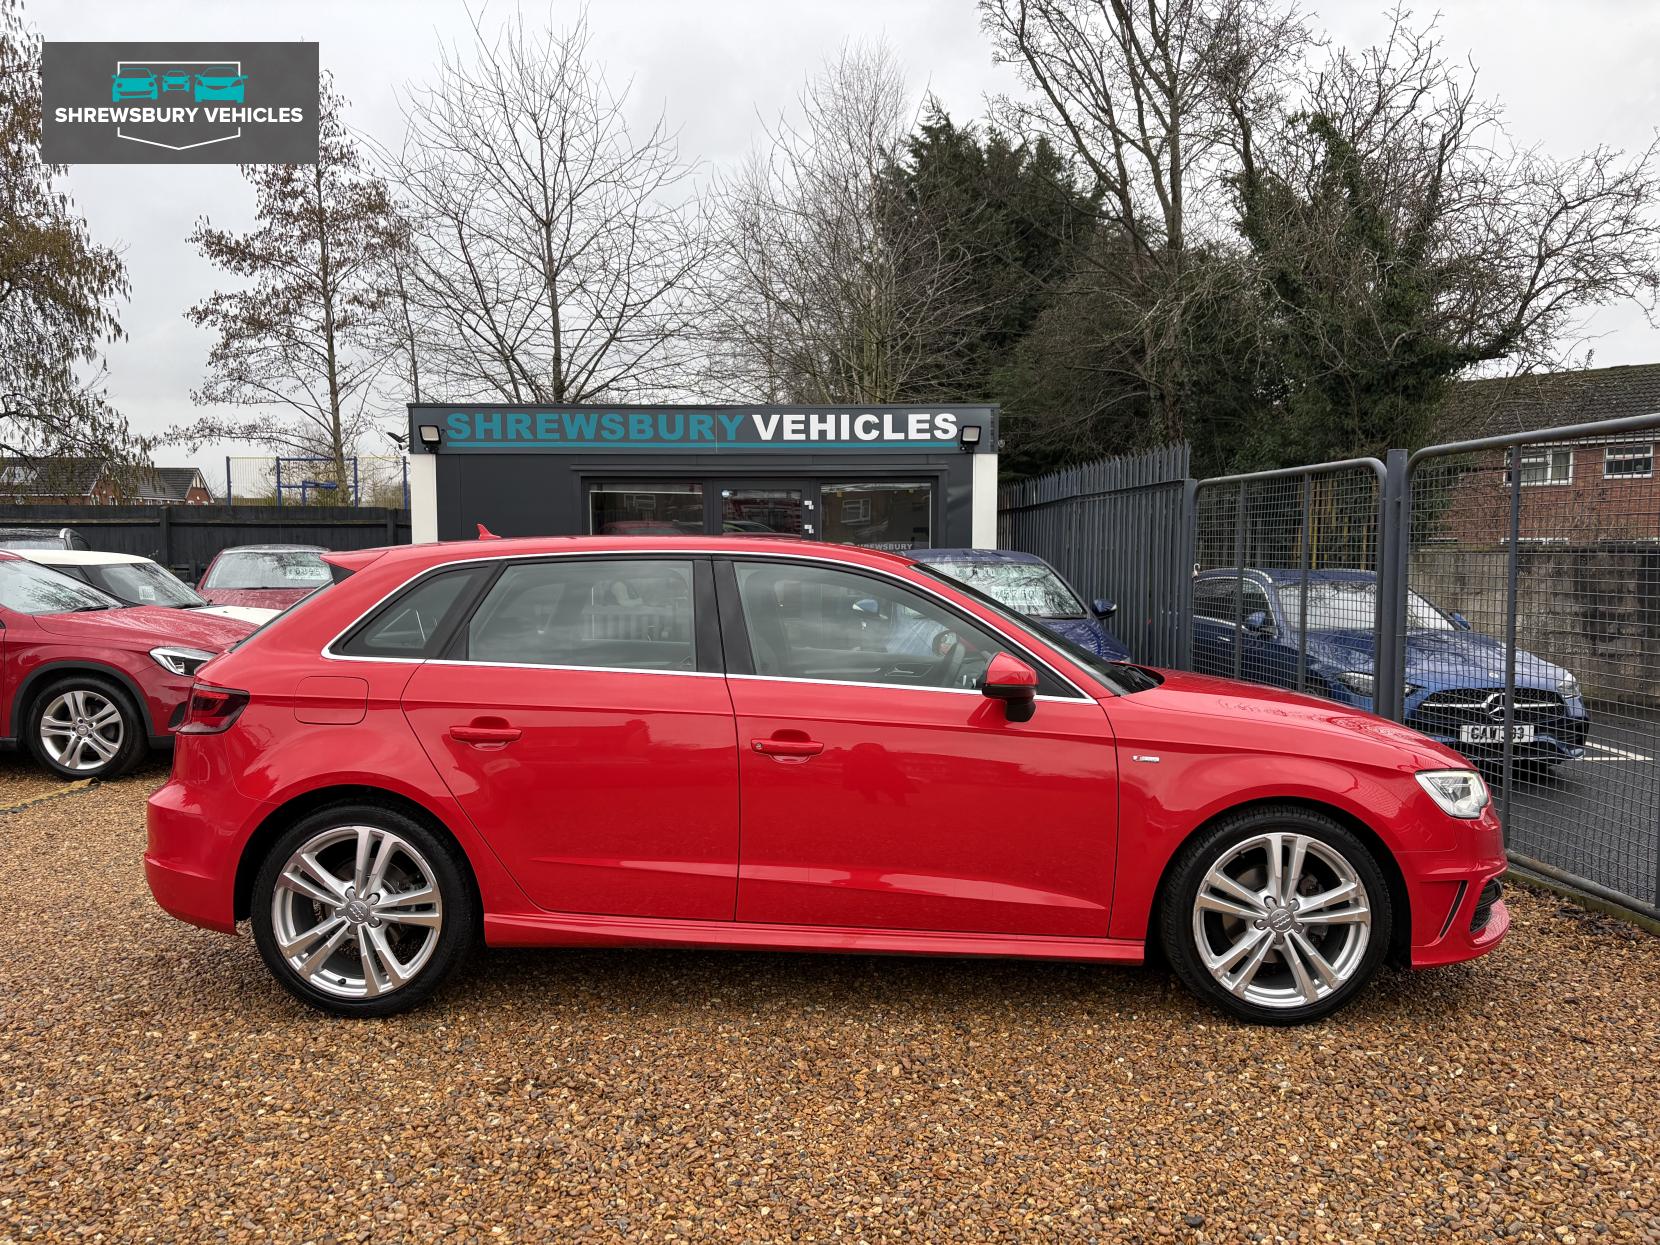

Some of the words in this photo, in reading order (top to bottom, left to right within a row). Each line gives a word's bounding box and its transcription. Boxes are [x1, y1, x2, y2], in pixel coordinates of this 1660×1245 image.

[448, 413, 744, 440] SHREWSBURY
[752, 414, 957, 440] VEHICLES
[857, 543, 912, 551] REWSBURY
